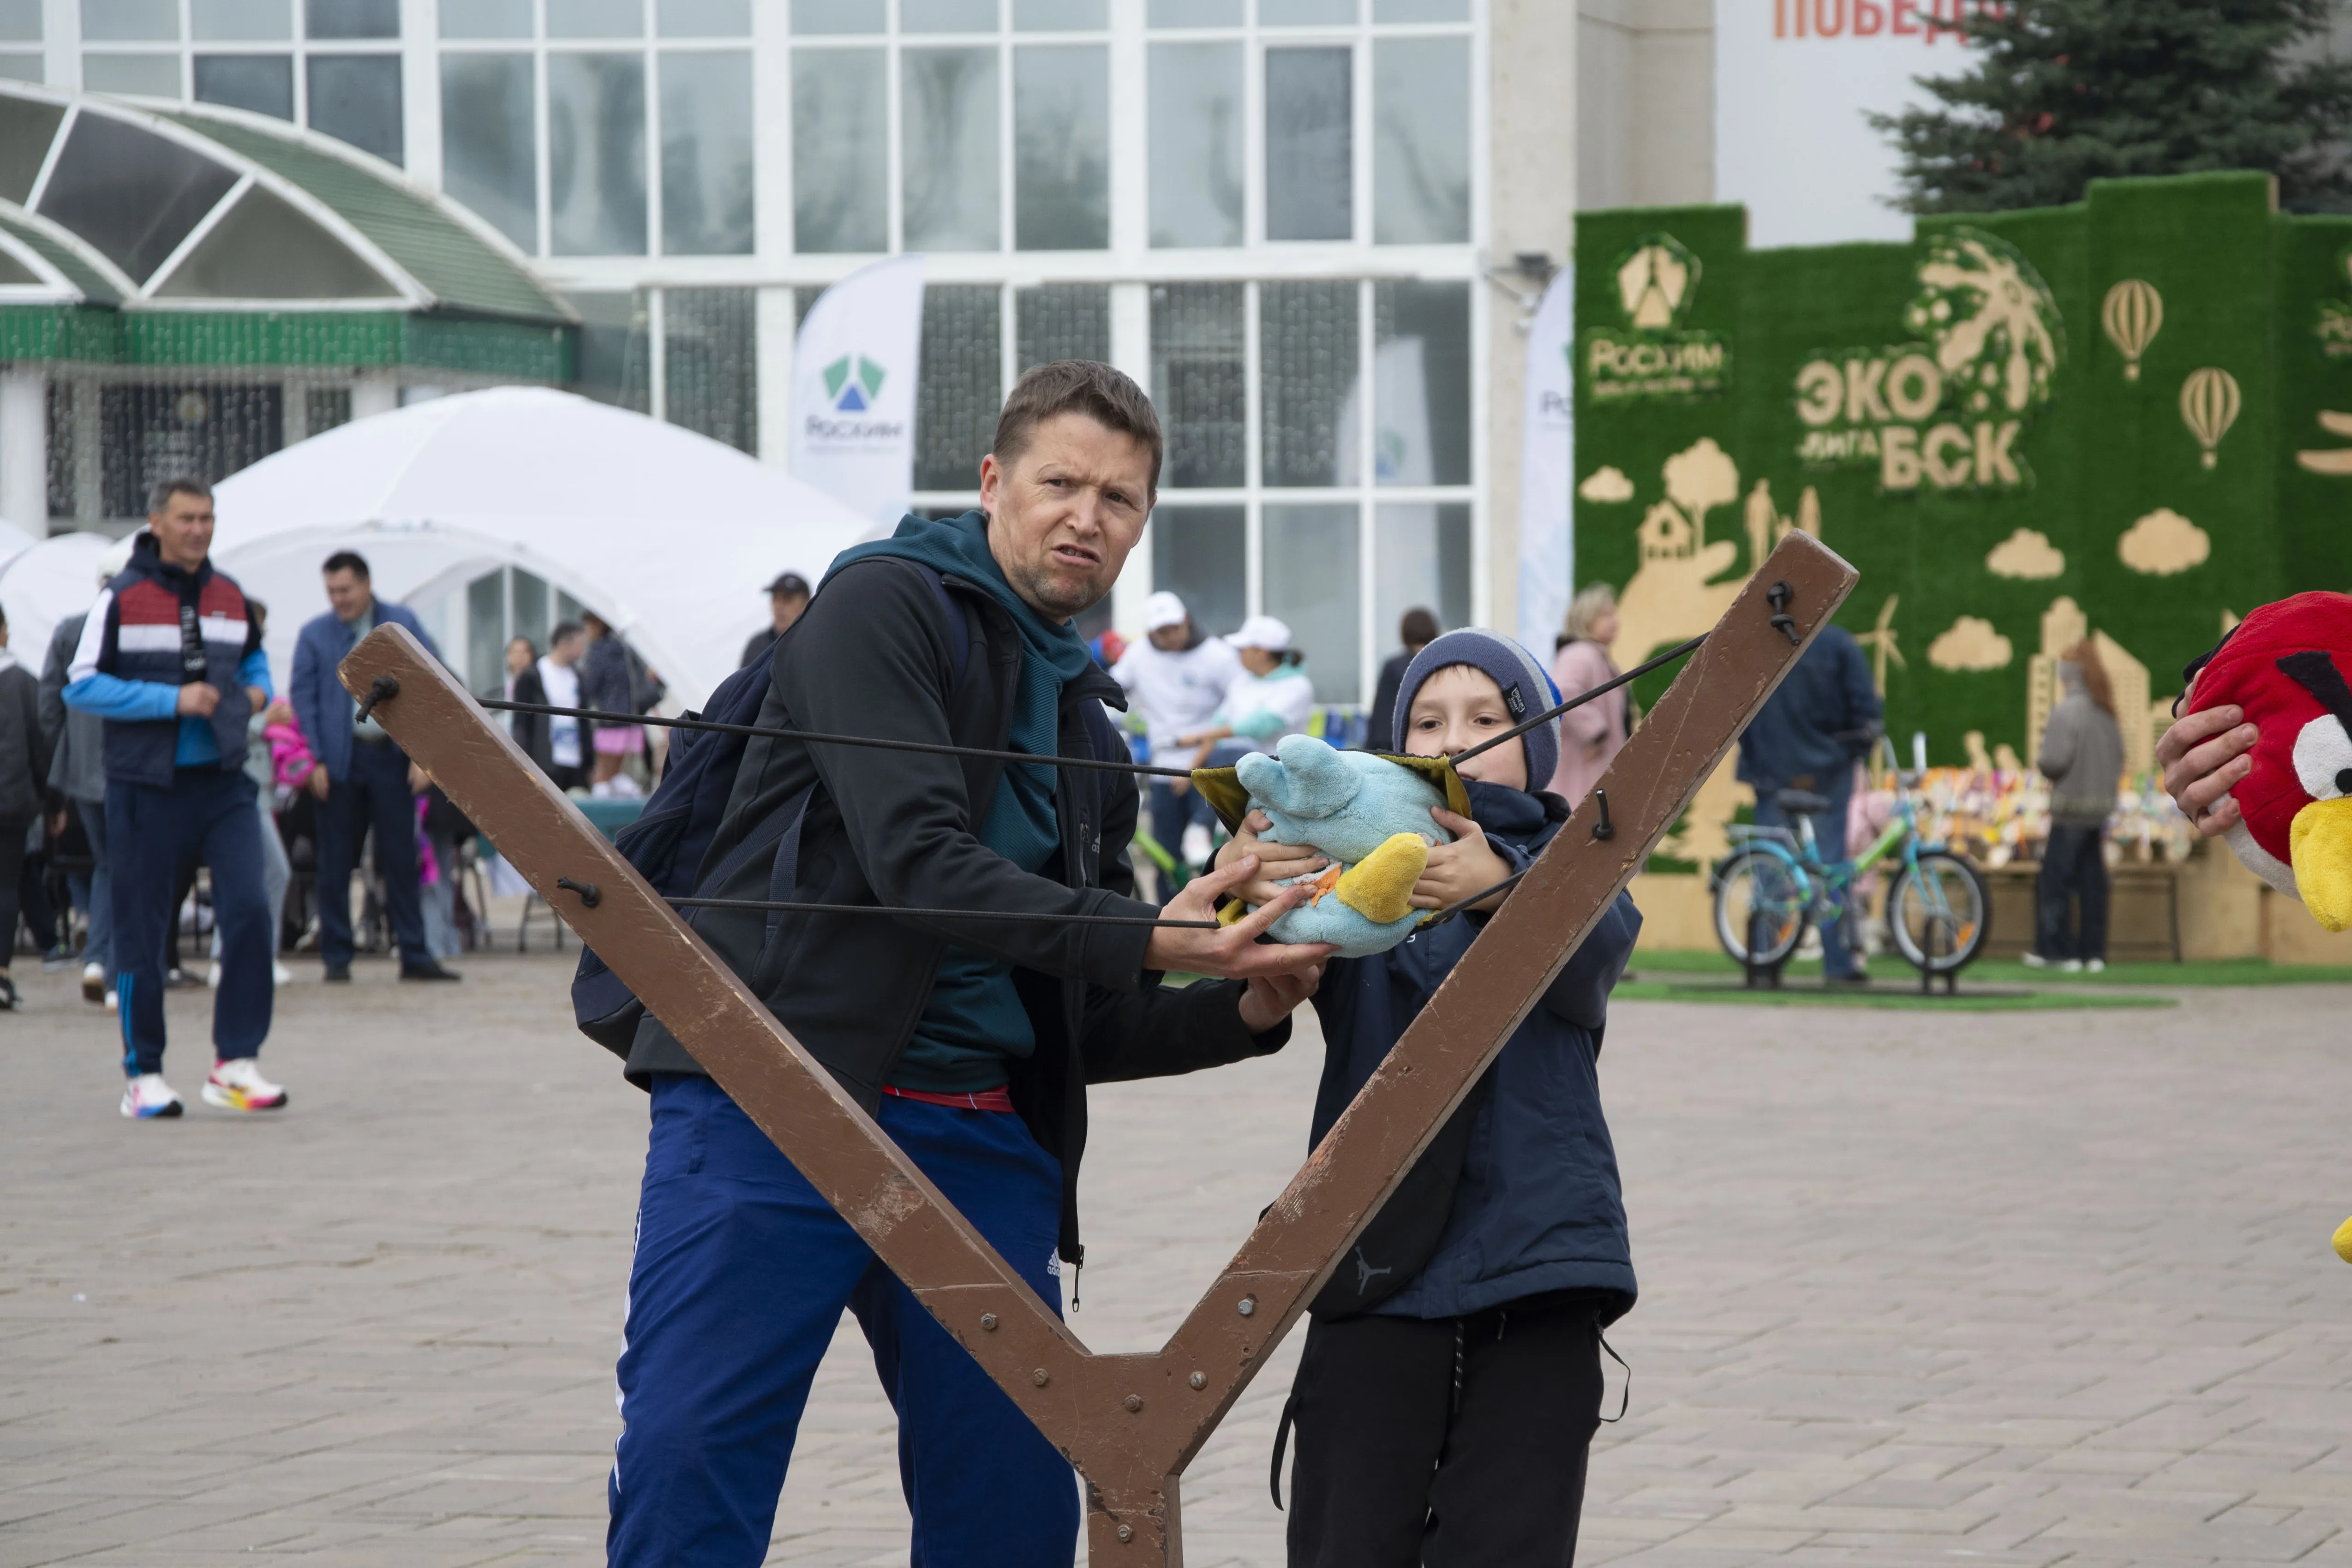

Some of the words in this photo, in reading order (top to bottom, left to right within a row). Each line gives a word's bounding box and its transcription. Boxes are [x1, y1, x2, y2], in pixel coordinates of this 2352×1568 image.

[1773, 0, 2006, 45] ПОБЕД
[1796, 353, 1942, 425] ЭКО
[1881, 419, 2021, 490] БСК
[1047, 1266, 1060, 1277] adid
